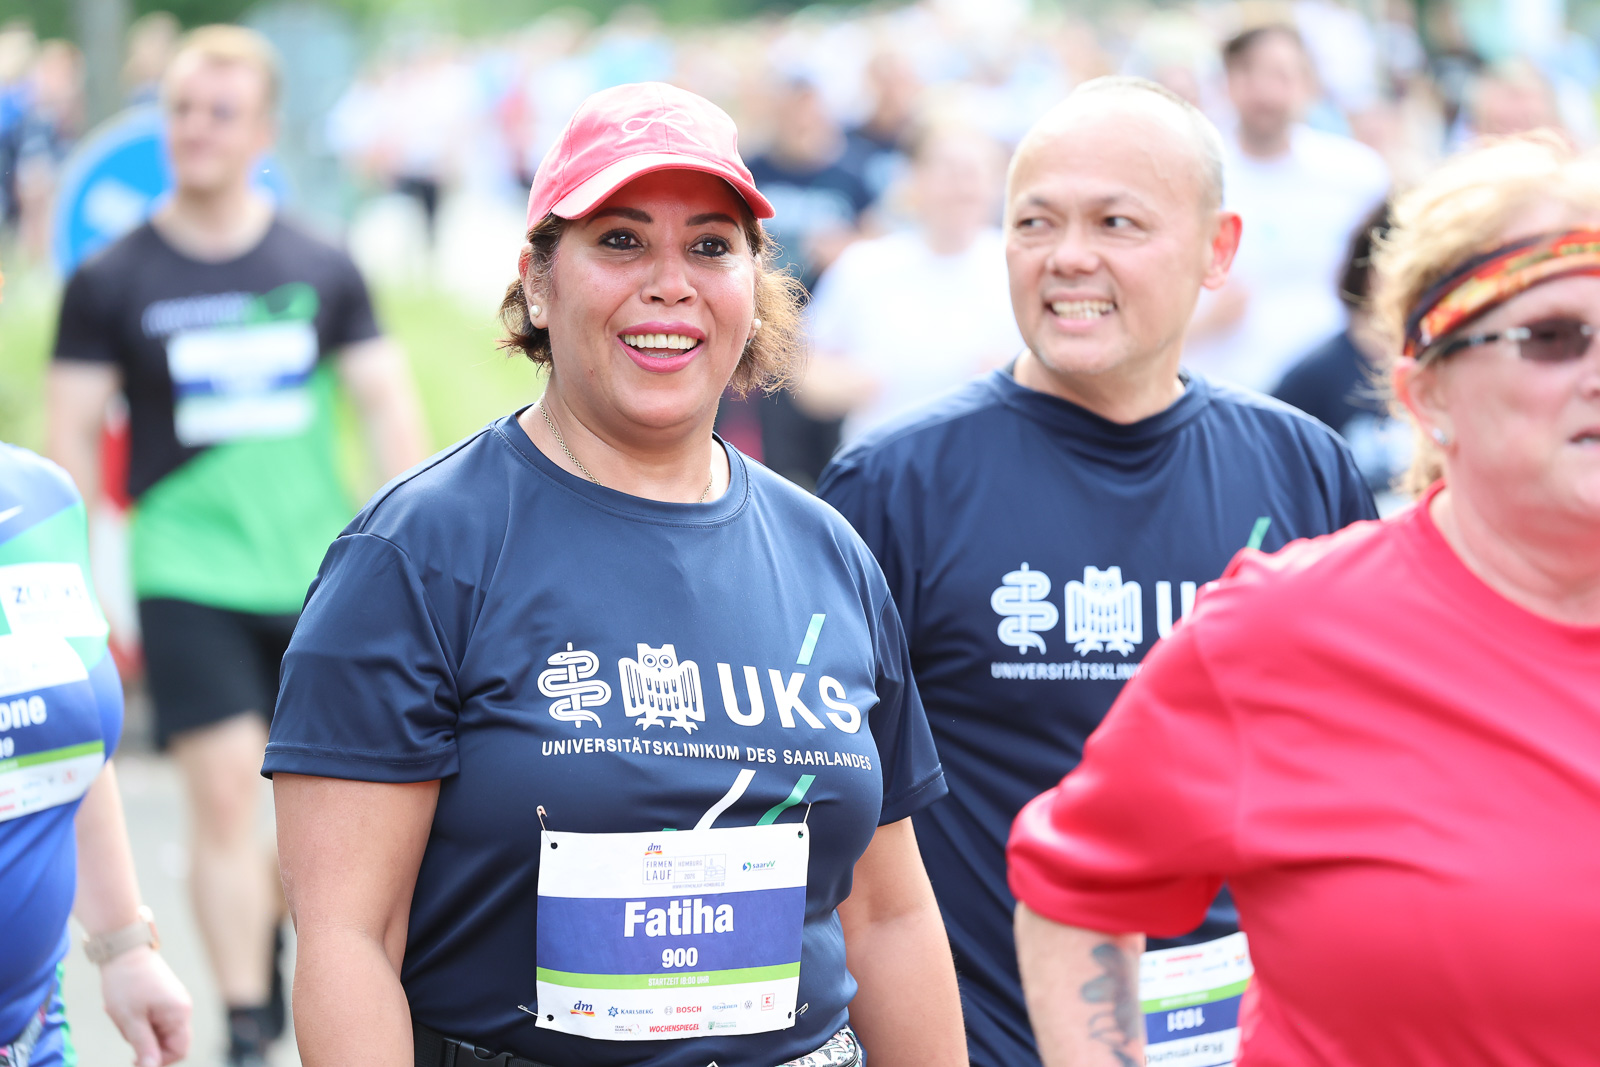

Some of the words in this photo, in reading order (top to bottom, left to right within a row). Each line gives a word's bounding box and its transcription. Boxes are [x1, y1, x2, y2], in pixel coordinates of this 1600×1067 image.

[717, 662, 862, 734] UKS
[541, 737, 740, 761] UNIVERSITÄTSKLINIKUM
[746, 747, 777, 763] DES
[783, 749, 872, 771] SAARLANDES
[647, 843, 662, 851] dm
[646, 860, 673, 868] FIRMEN
[677, 859, 703, 867] HOMBURG
[646, 869, 672, 881] LAUF
[624, 898, 734, 937] Fatiha
[661, 947, 698, 968] 900
[648, 977, 679, 986] STARTZEIT
[697, 975, 710, 984] UHR
[573, 1000, 593, 1011] dm
[649, 1024, 699, 1033] WOCHENSPIEGEL
